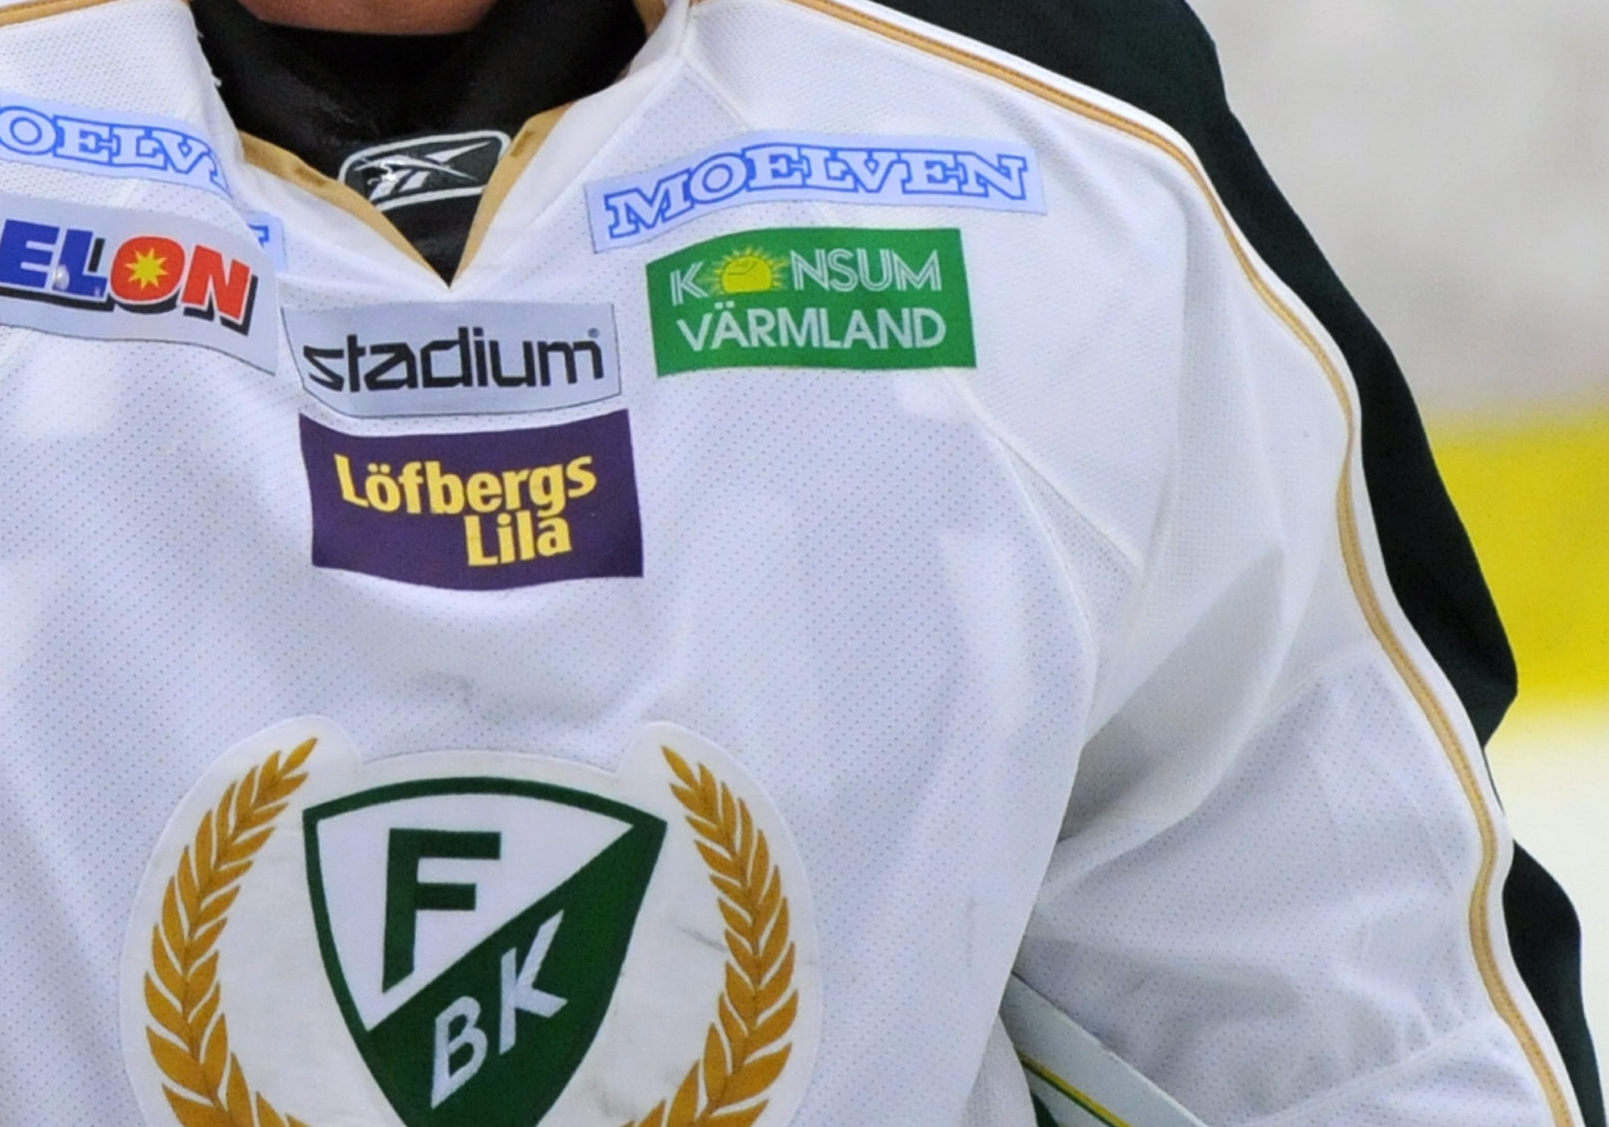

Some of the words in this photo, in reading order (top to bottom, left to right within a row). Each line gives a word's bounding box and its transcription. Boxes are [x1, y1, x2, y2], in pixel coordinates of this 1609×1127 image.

[603, 142, 1029, 241] MOELVEN
[676, 301, 947, 352] VÄRMLAND
[303, 327, 605, 392] stadium
[334, 453, 597, 517] Löfbergs
[464, 510, 572, 566] Lila
